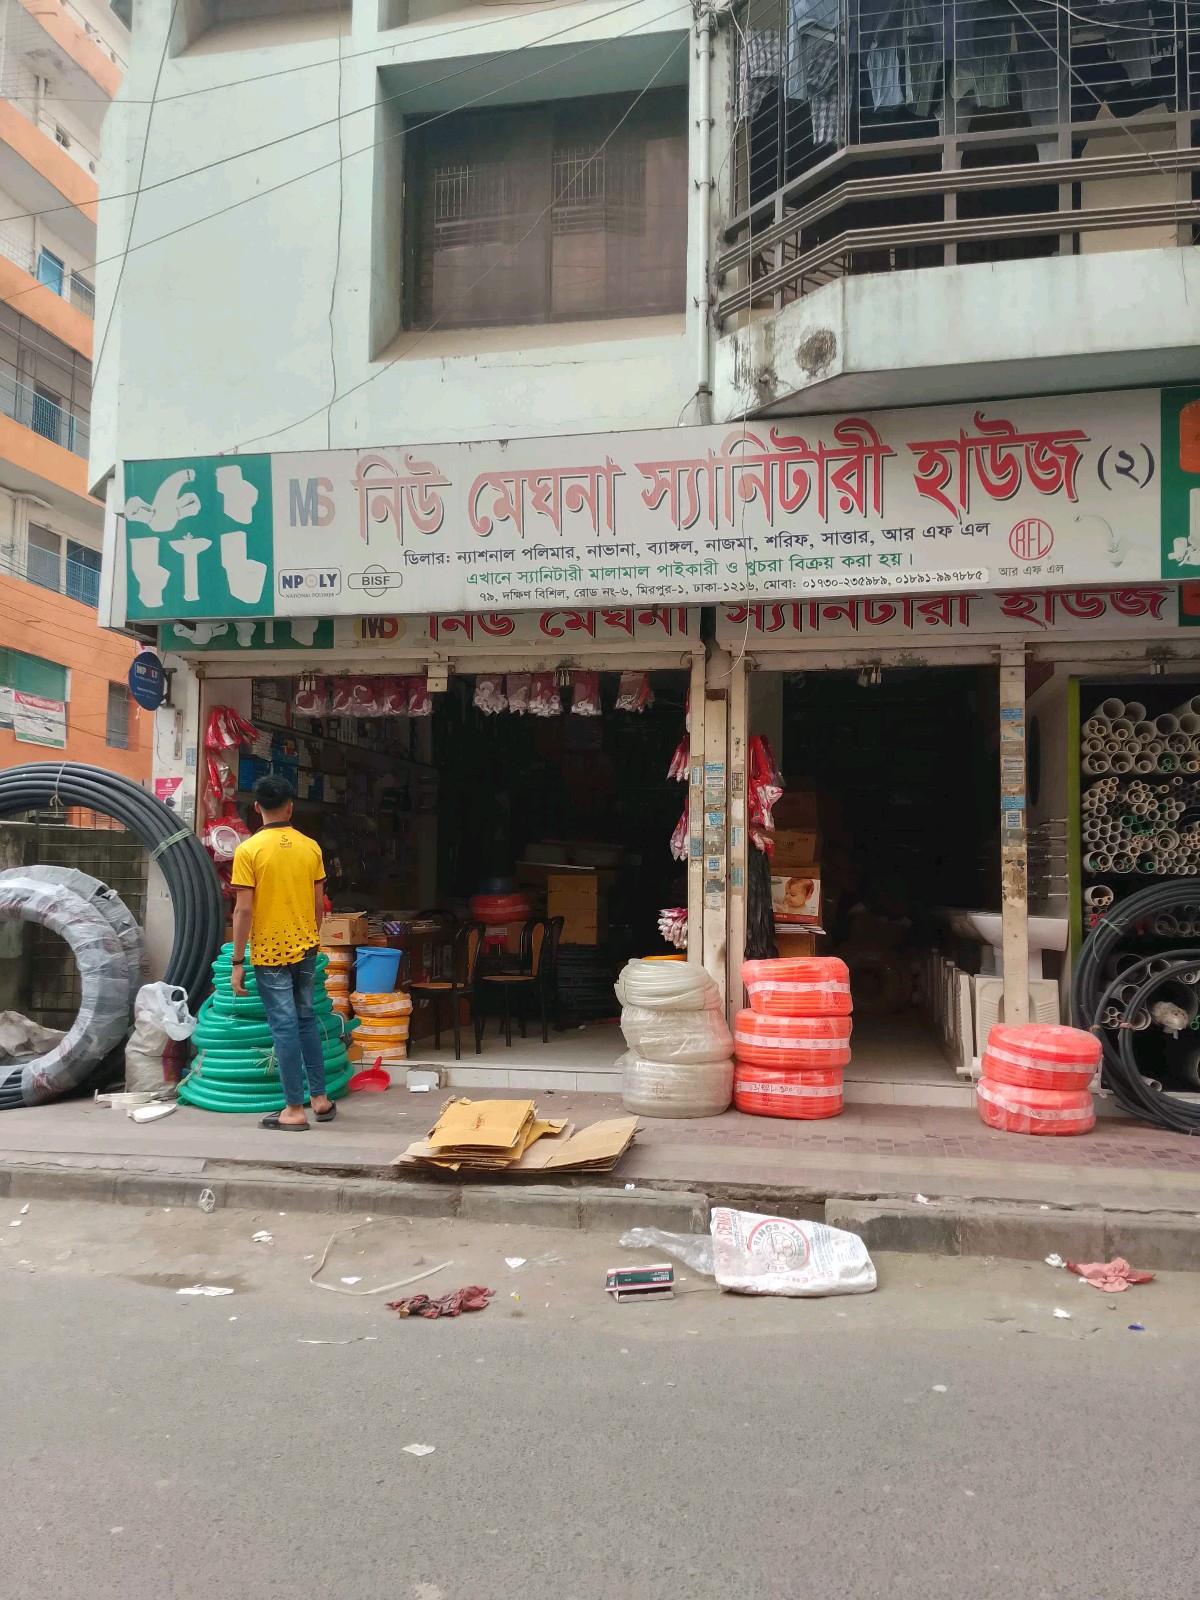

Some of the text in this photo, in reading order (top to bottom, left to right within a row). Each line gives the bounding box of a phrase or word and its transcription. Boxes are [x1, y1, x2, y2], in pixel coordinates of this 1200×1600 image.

[350, 410, 1155, 546] নিউ মেঘনা স্যানিটারী হাউজ (২)
[403, 550, 450, 566] ডিলার:
[456, 549, 515, 564] ন্যাশনাল
[522, 543, 580, 561] পলিমার,
[586, 541, 641, 558] নাভানা,
[704, 538, 758, 553] নাজমা,
[764, 531, 814, 550] শরিফ,
[821, 529, 874, 546] সাত্তার,
[882, 527, 915, 541] আর
[922, 525, 954, 539] এফ
[960, 521, 990, 537] এল
[1014, 521, 1049, 558] RFL
[467, 571, 511, 585] এখানে
[517, 564, 583, 584] স্যানিটারী
[588, 564, 650, 580] মালামাল
[656, 558, 719, 577] পাইকারী
[726, 561, 738, 574] ও
[746, 558, 784, 576] খুচরা
[789, 553, 835, 572] বিক্রয়
[838, 553, 873, 569] করা
[998, 563, 1064, 577] আর এফ এল
[282, 574, 338, 590] NPOLY
[361, 576, 391, 586] BISF
[502, 589, 531, 601] দক্ষিণ
[535, 587, 569, 600] বিশিল,
[573, 587, 598, 599] রোড
[636, 583, 688, 597] মিরপুর-১,
[753, 1223, 779, 1246] RINGS
